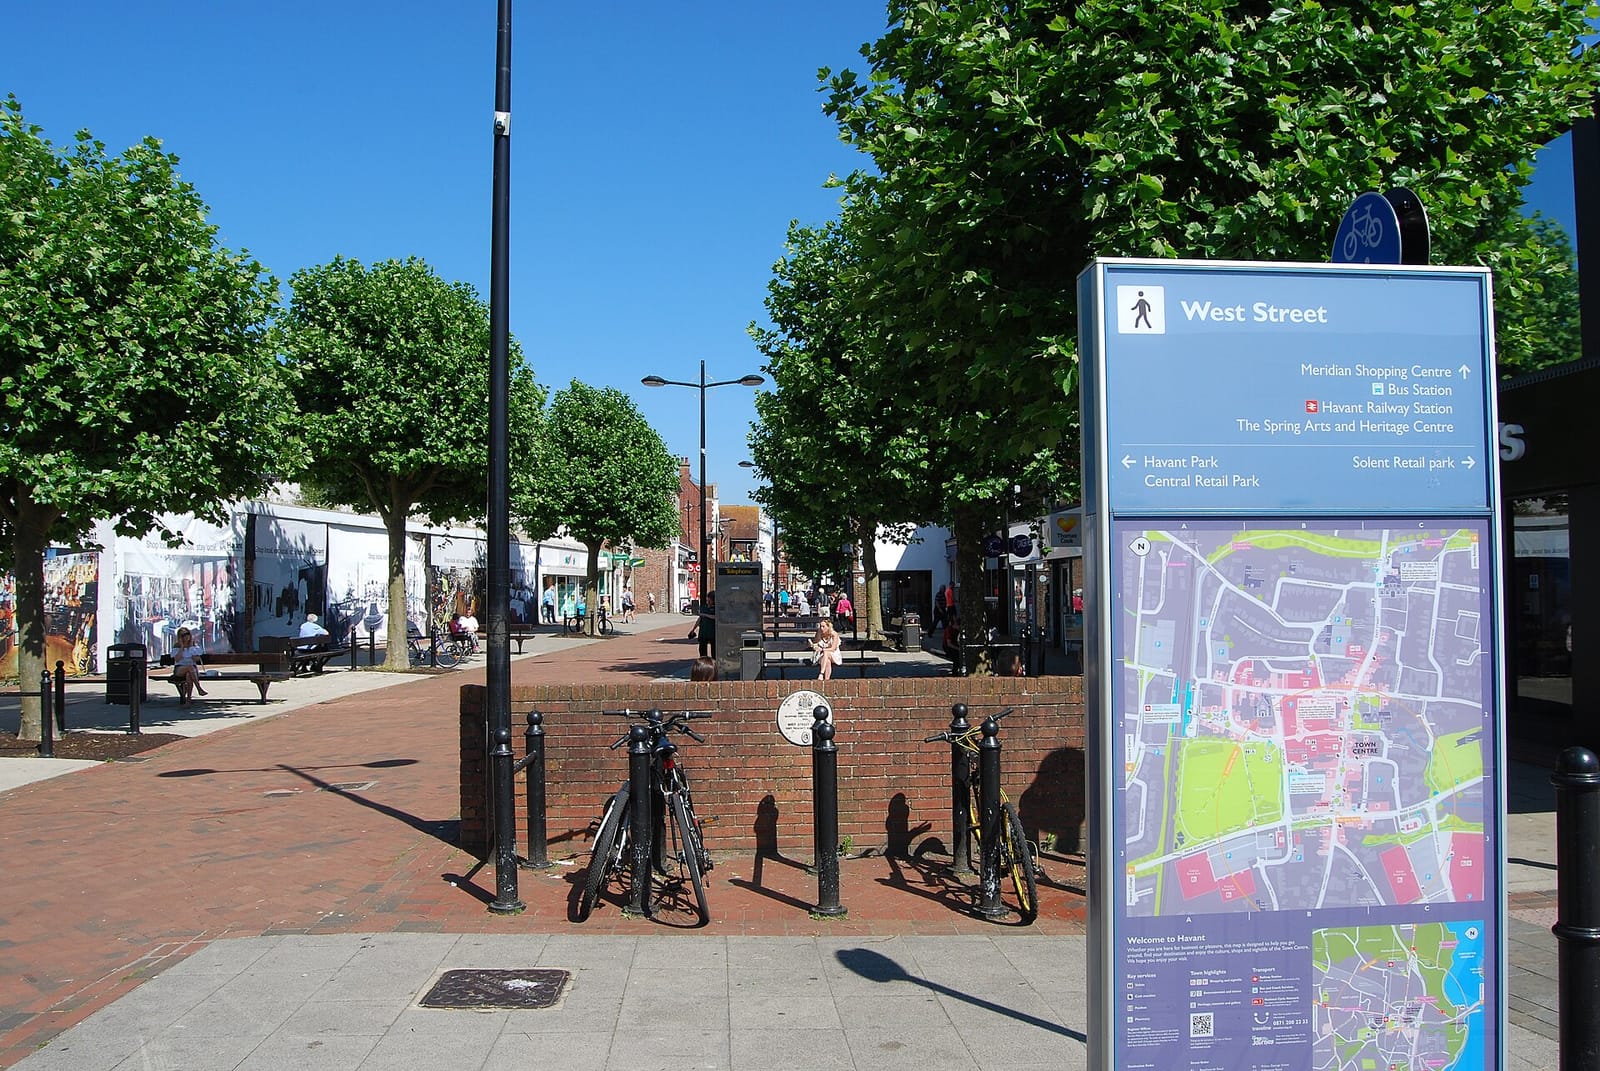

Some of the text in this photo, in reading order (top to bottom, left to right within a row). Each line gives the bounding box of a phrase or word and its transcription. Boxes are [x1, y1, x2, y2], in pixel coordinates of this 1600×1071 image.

[1180, 300, 1328, 324] West Street
[1300, 364, 1452, 380] Meridian Shopping Centre
[1388, 384, 1452, 396] Bus Station
[1322, 401, 1453, 416] Havant Railway Station
[1236, 419, 1454, 436] The Spring Arts and Heritage Centre
[1144, 455, 1218, 468] Havant Park
[1352, 456, 1455, 473] Solent Retail park
[1144, 474, 1260, 488] Central Retail Park
